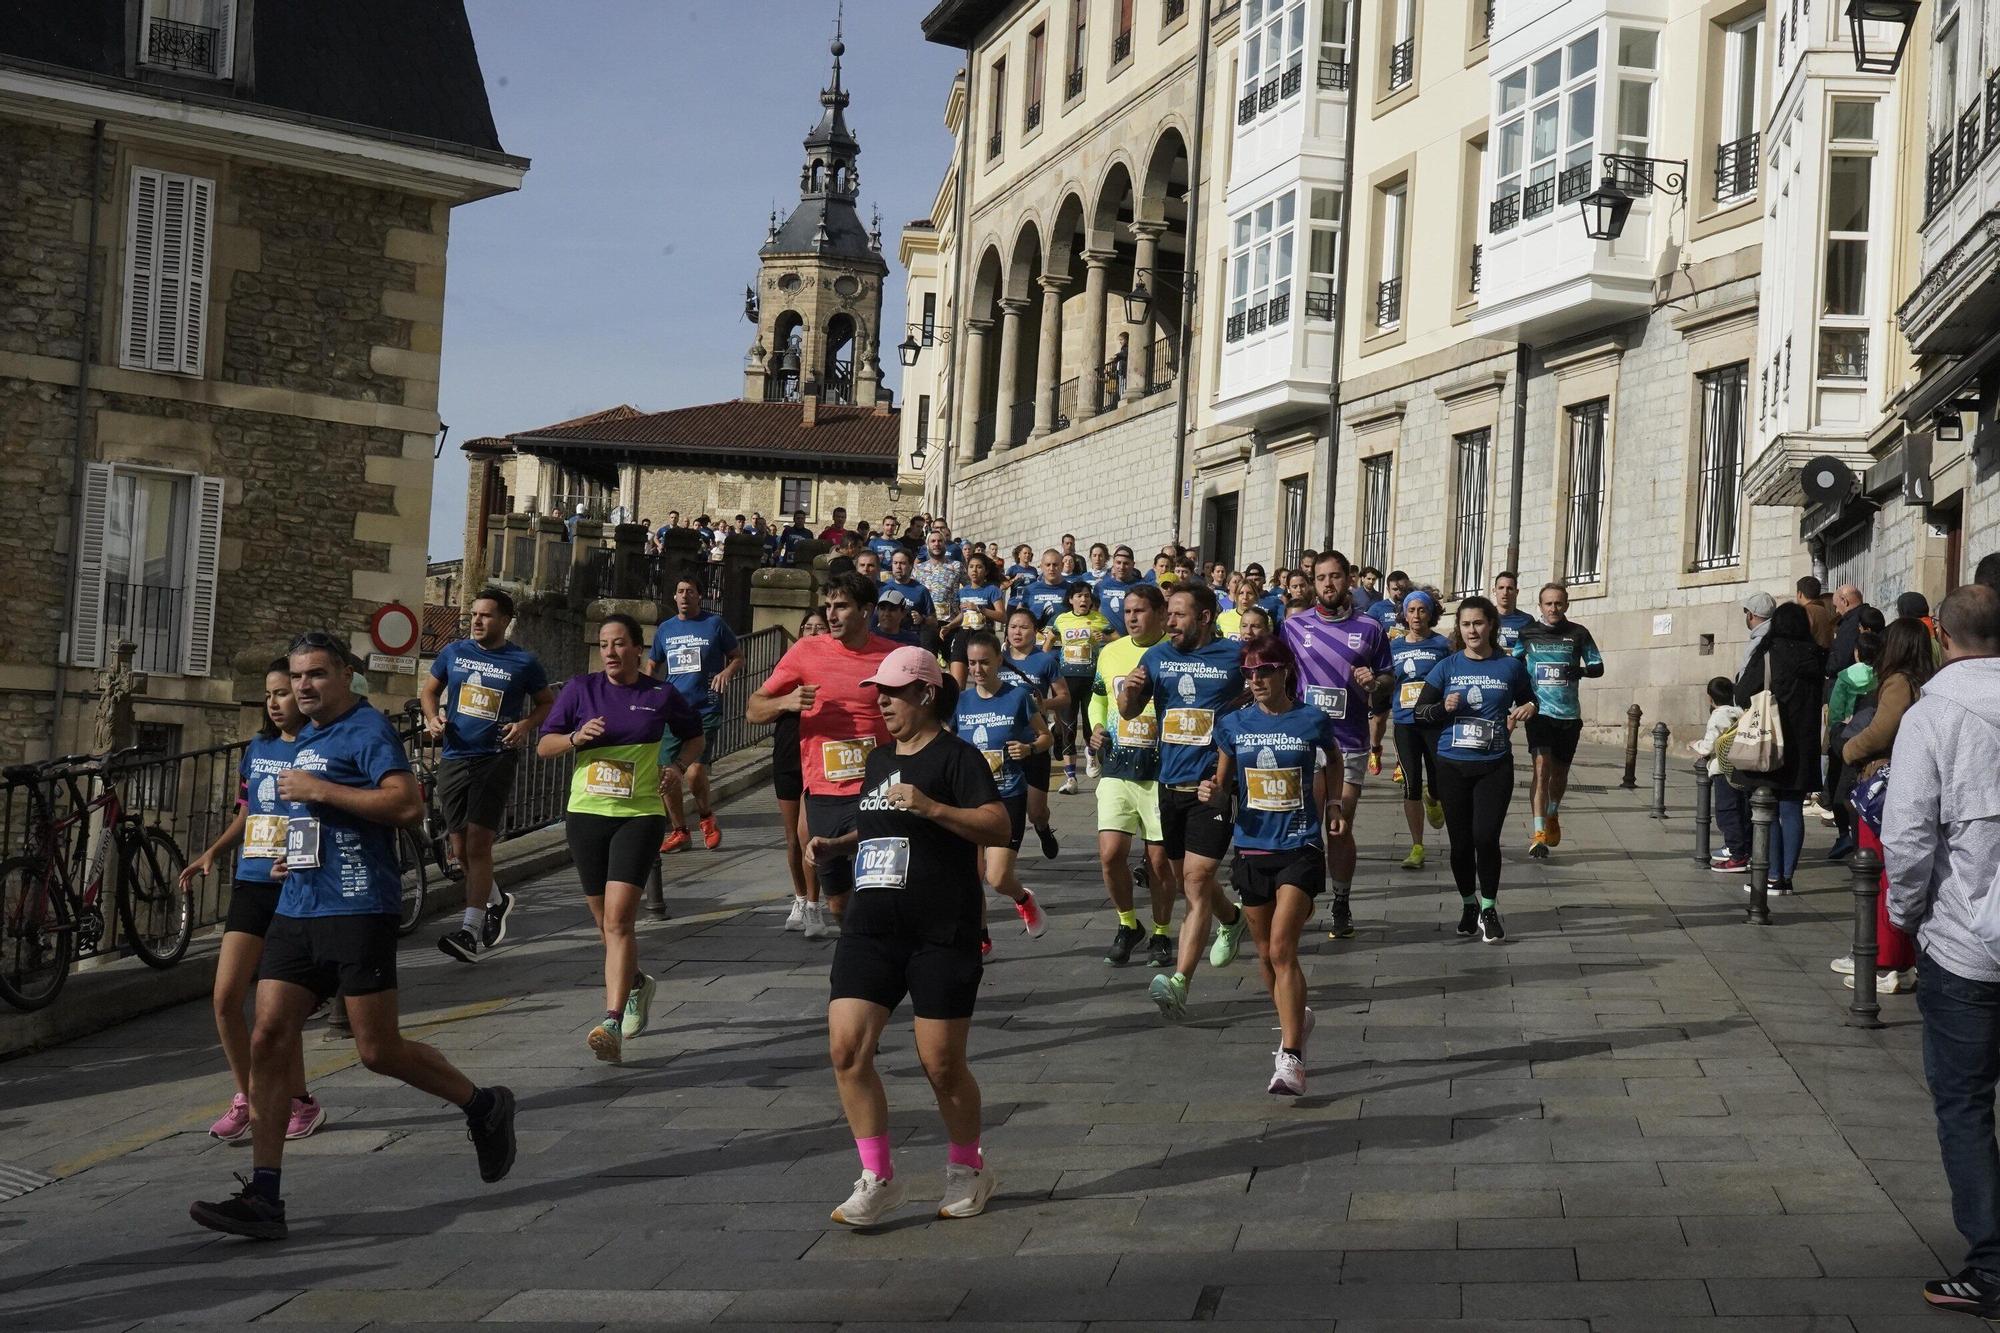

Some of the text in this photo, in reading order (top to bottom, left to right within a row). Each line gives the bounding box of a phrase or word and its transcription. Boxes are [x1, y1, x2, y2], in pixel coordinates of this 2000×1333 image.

[1935, 525, 1941, 536] 2
[676, 653, 692, 665] 733
[461, 662, 504, 674] ALMENDRA
[1168, 665, 1218, 673] ALMENDRA
[1544, 668, 1560, 678] 746
[471, 692, 490, 707] 144
[1313, 693, 1338, 707] 1057
[965, 715, 1006, 725] ALMENDRA
[1179, 717, 1196, 731] 98
[1127, 721, 1149, 735] 433
[1462, 724, 1483, 737] 845
[1244, 737, 1302, 746] ALMENDRA
[838, 748, 863, 765] 128
[1260, 779, 1287, 795] 149
[251, 824, 277, 844] 647
[862, 849, 896, 870] 1022
